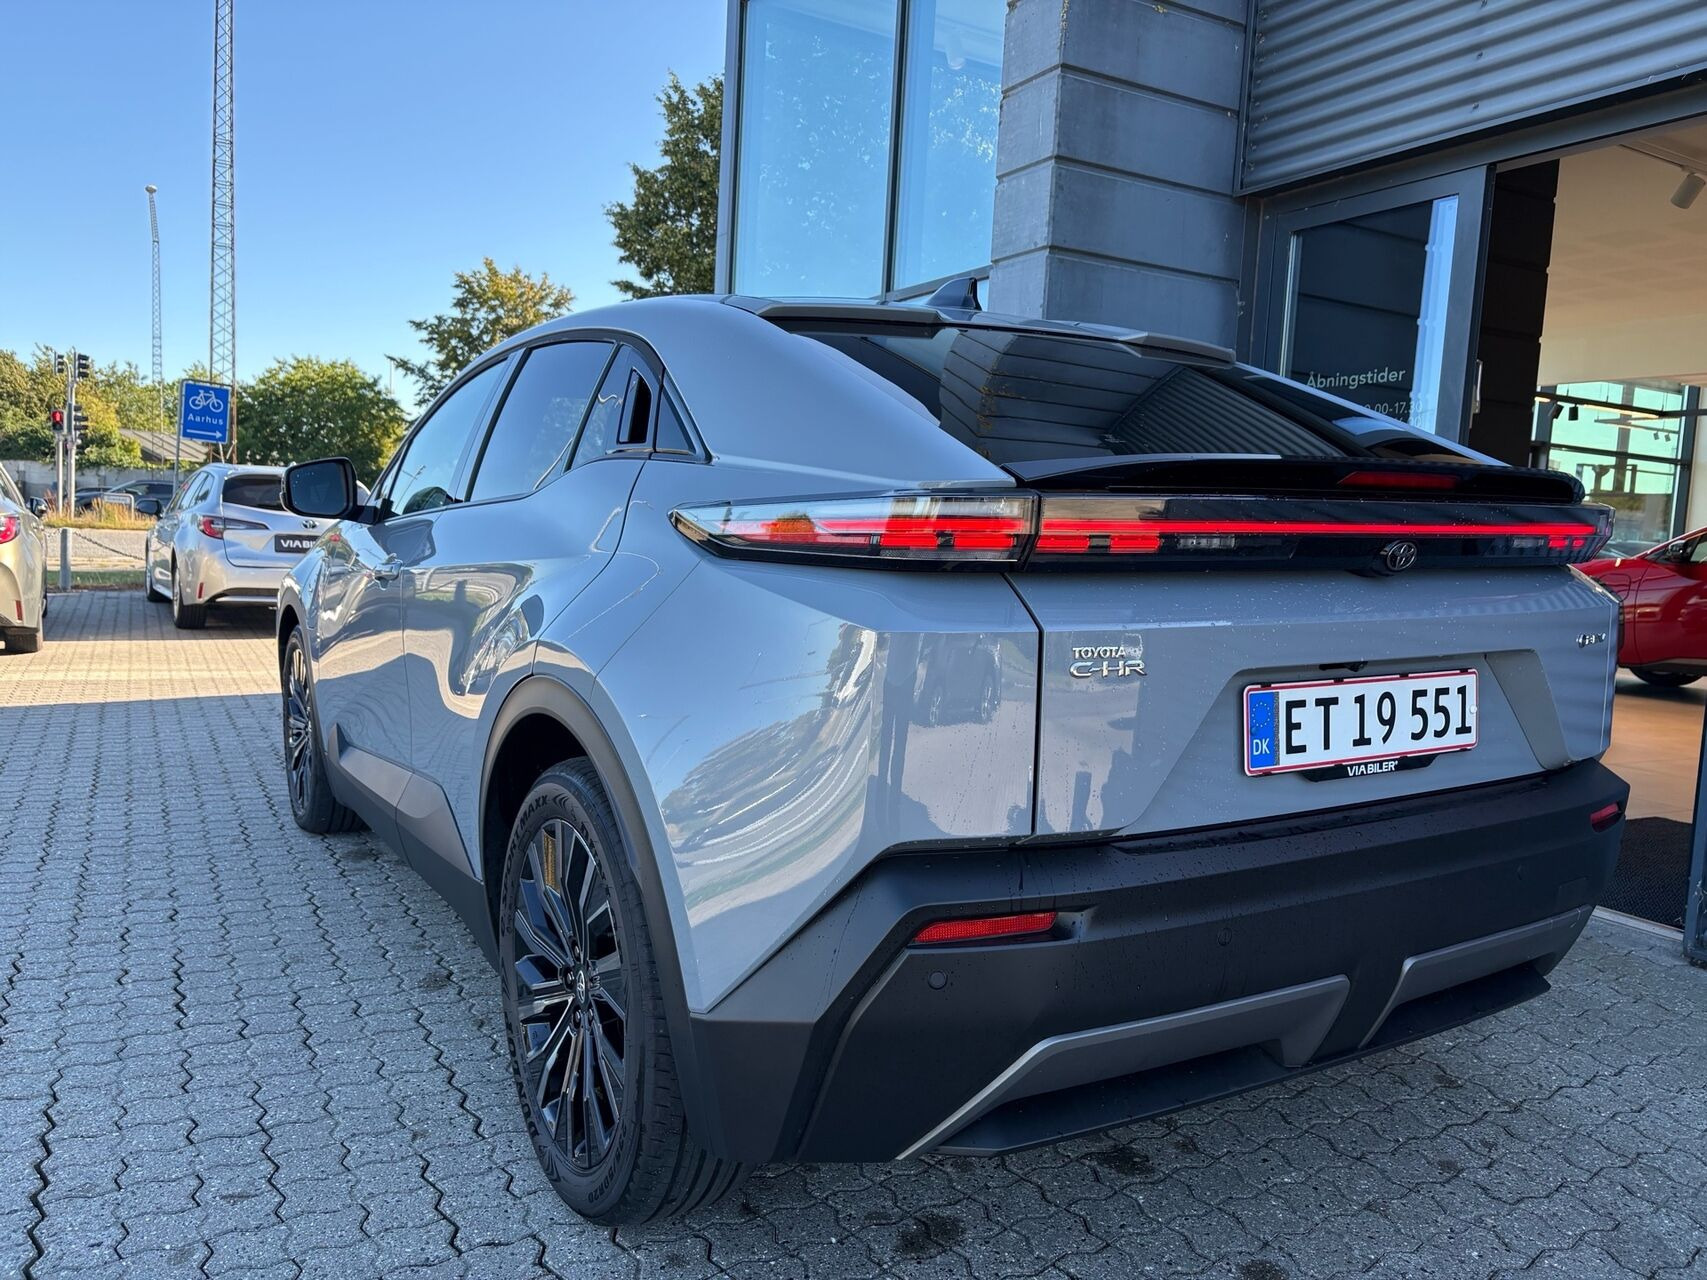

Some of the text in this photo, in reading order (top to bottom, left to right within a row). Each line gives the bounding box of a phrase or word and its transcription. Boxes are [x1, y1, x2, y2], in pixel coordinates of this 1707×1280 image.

[1307, 367, 1406, 389] Åbningstider
[187, 413, 224, 426] Aarhus
[1072, 646, 1126, 659] TOYOTA
[1070, 660, 1147, 677] C-HR
[1285, 685, 1472, 755] ET 19 551
[1253, 738, 1271, 755] DK
[520, 795, 548, 830] MAXX
